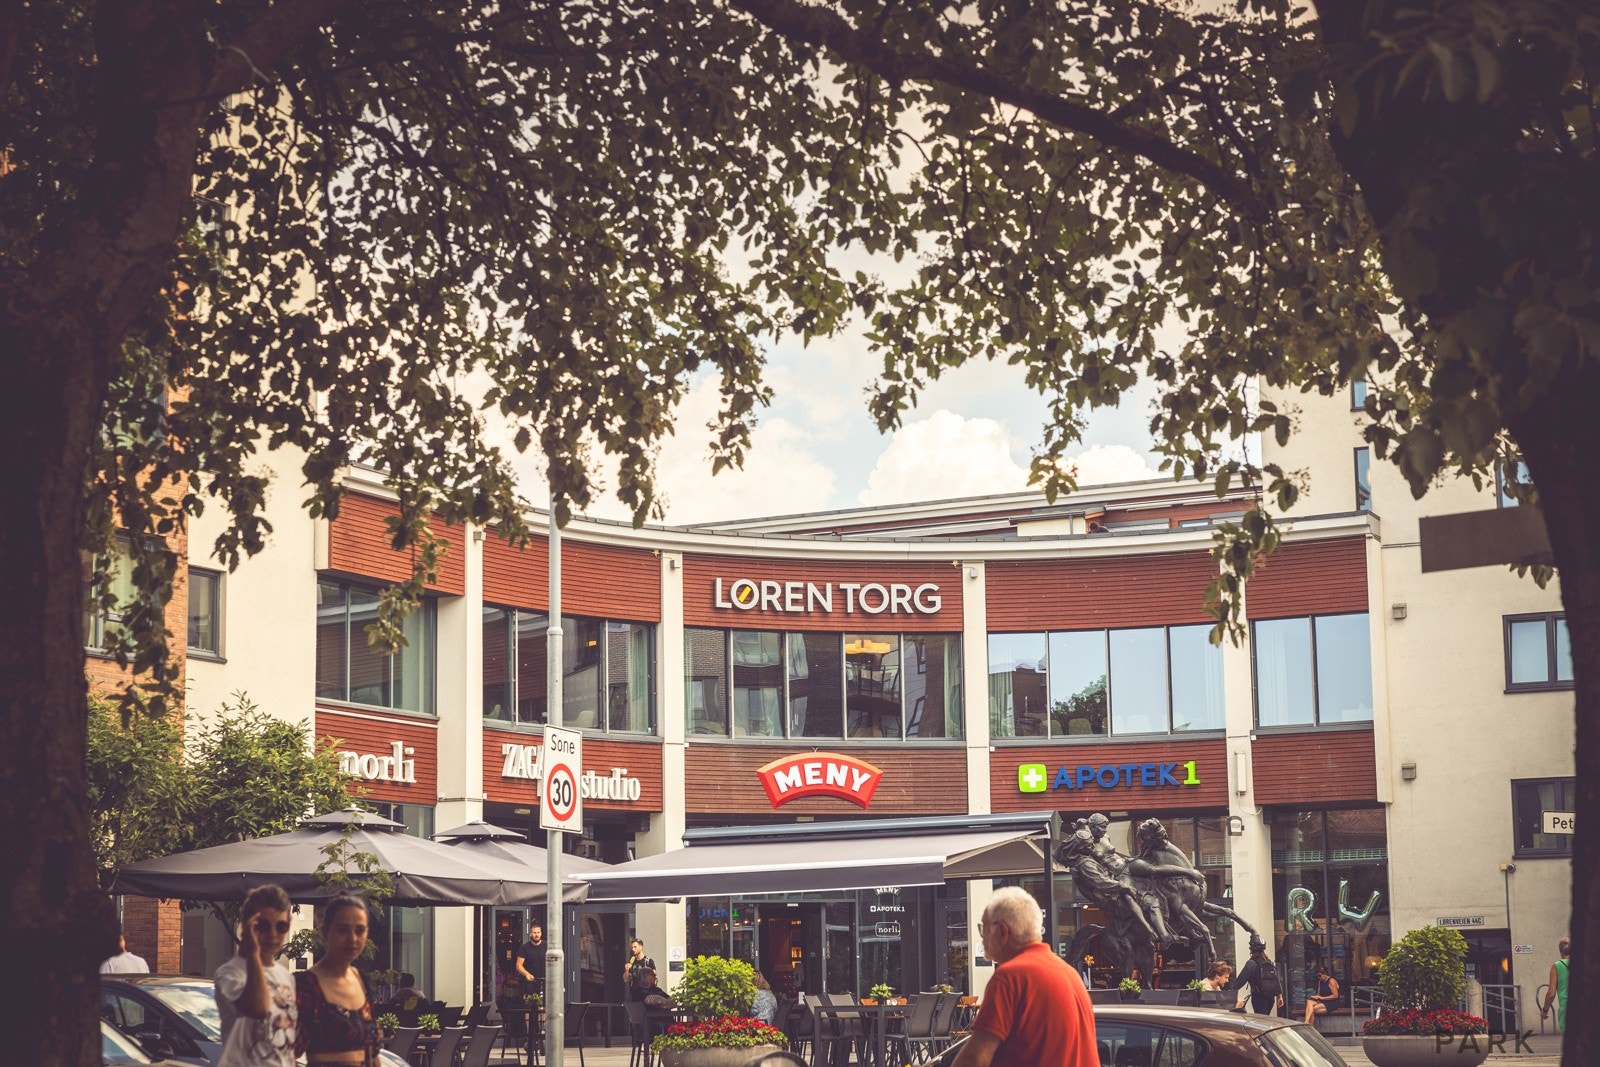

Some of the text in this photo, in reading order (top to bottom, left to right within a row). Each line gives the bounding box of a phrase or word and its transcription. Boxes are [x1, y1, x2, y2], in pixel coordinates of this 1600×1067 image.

[839, 582, 942, 614] TORG
[550, 733, 575, 755] Sone
[338, 740, 417, 783] norli
[1053, 760, 1201, 789] APOTEK 1
[552, 777, 572, 808] 30
[773, 762, 871, 793] MENY
[876, 887, 899, 895] MENY
